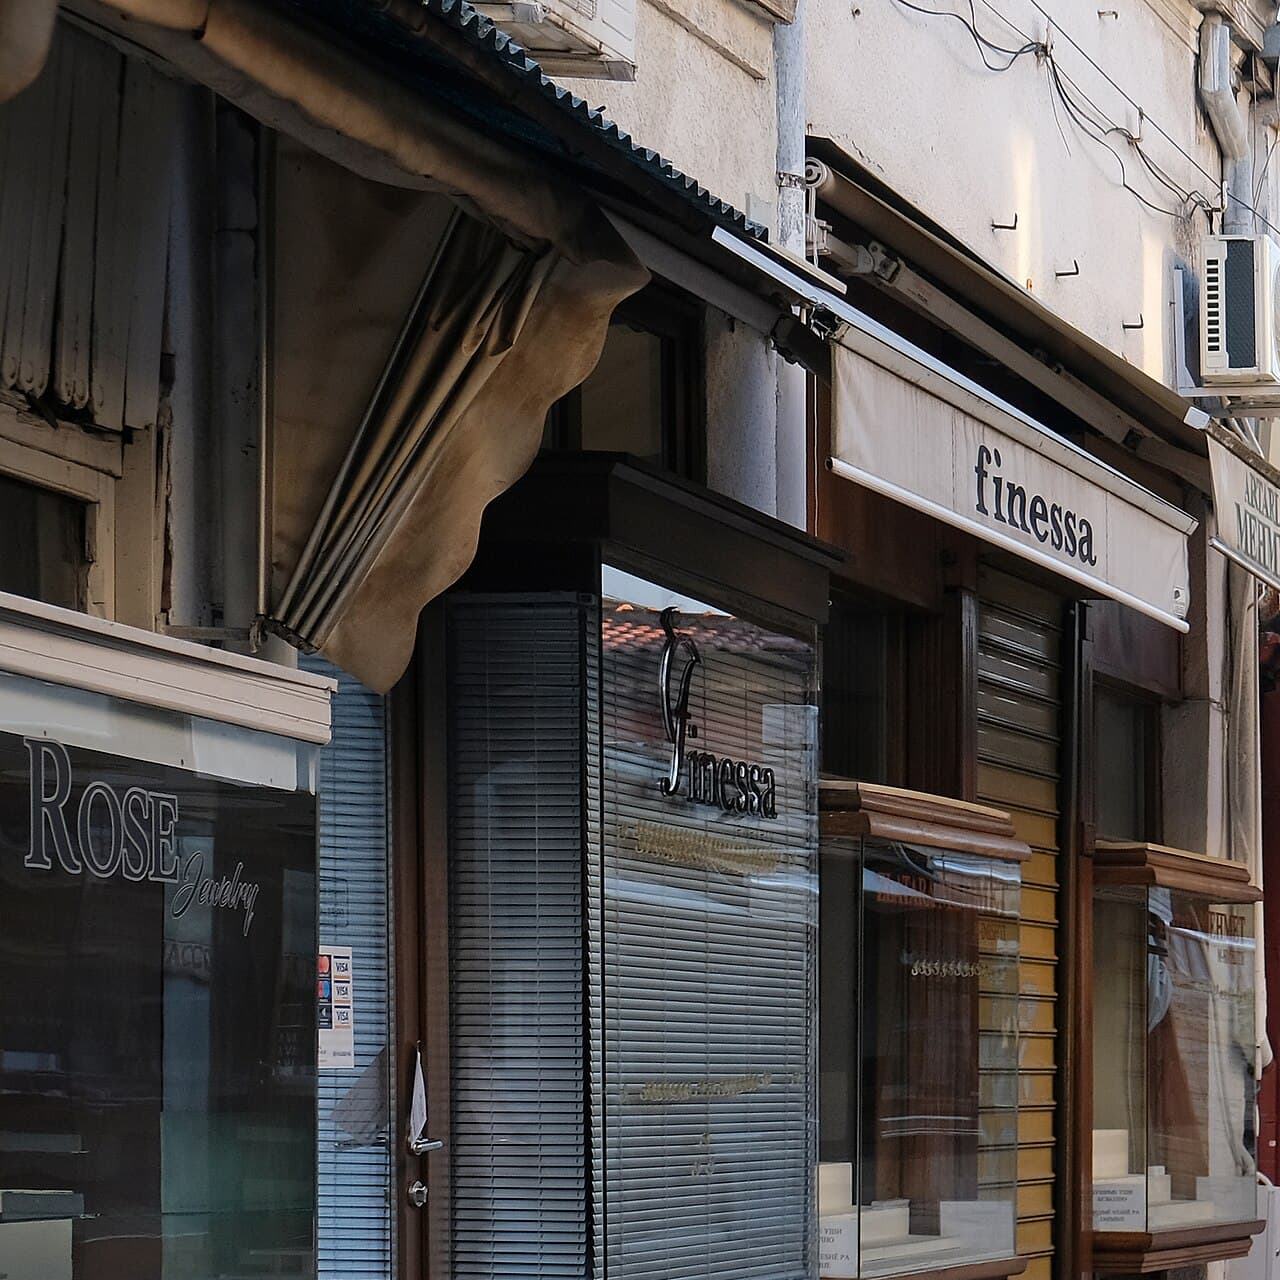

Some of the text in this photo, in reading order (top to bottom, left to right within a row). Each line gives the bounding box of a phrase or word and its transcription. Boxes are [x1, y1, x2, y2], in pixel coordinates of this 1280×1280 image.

[974, 444, 1097, 567] finessa
[23, 735, 179, 884] ROSE
[172, 850, 259, 937] Jewelry
[335, 962, 349, 973] VISA
[335, 986, 349, 997] VISA
[336, 1011, 349, 1021] VISA
